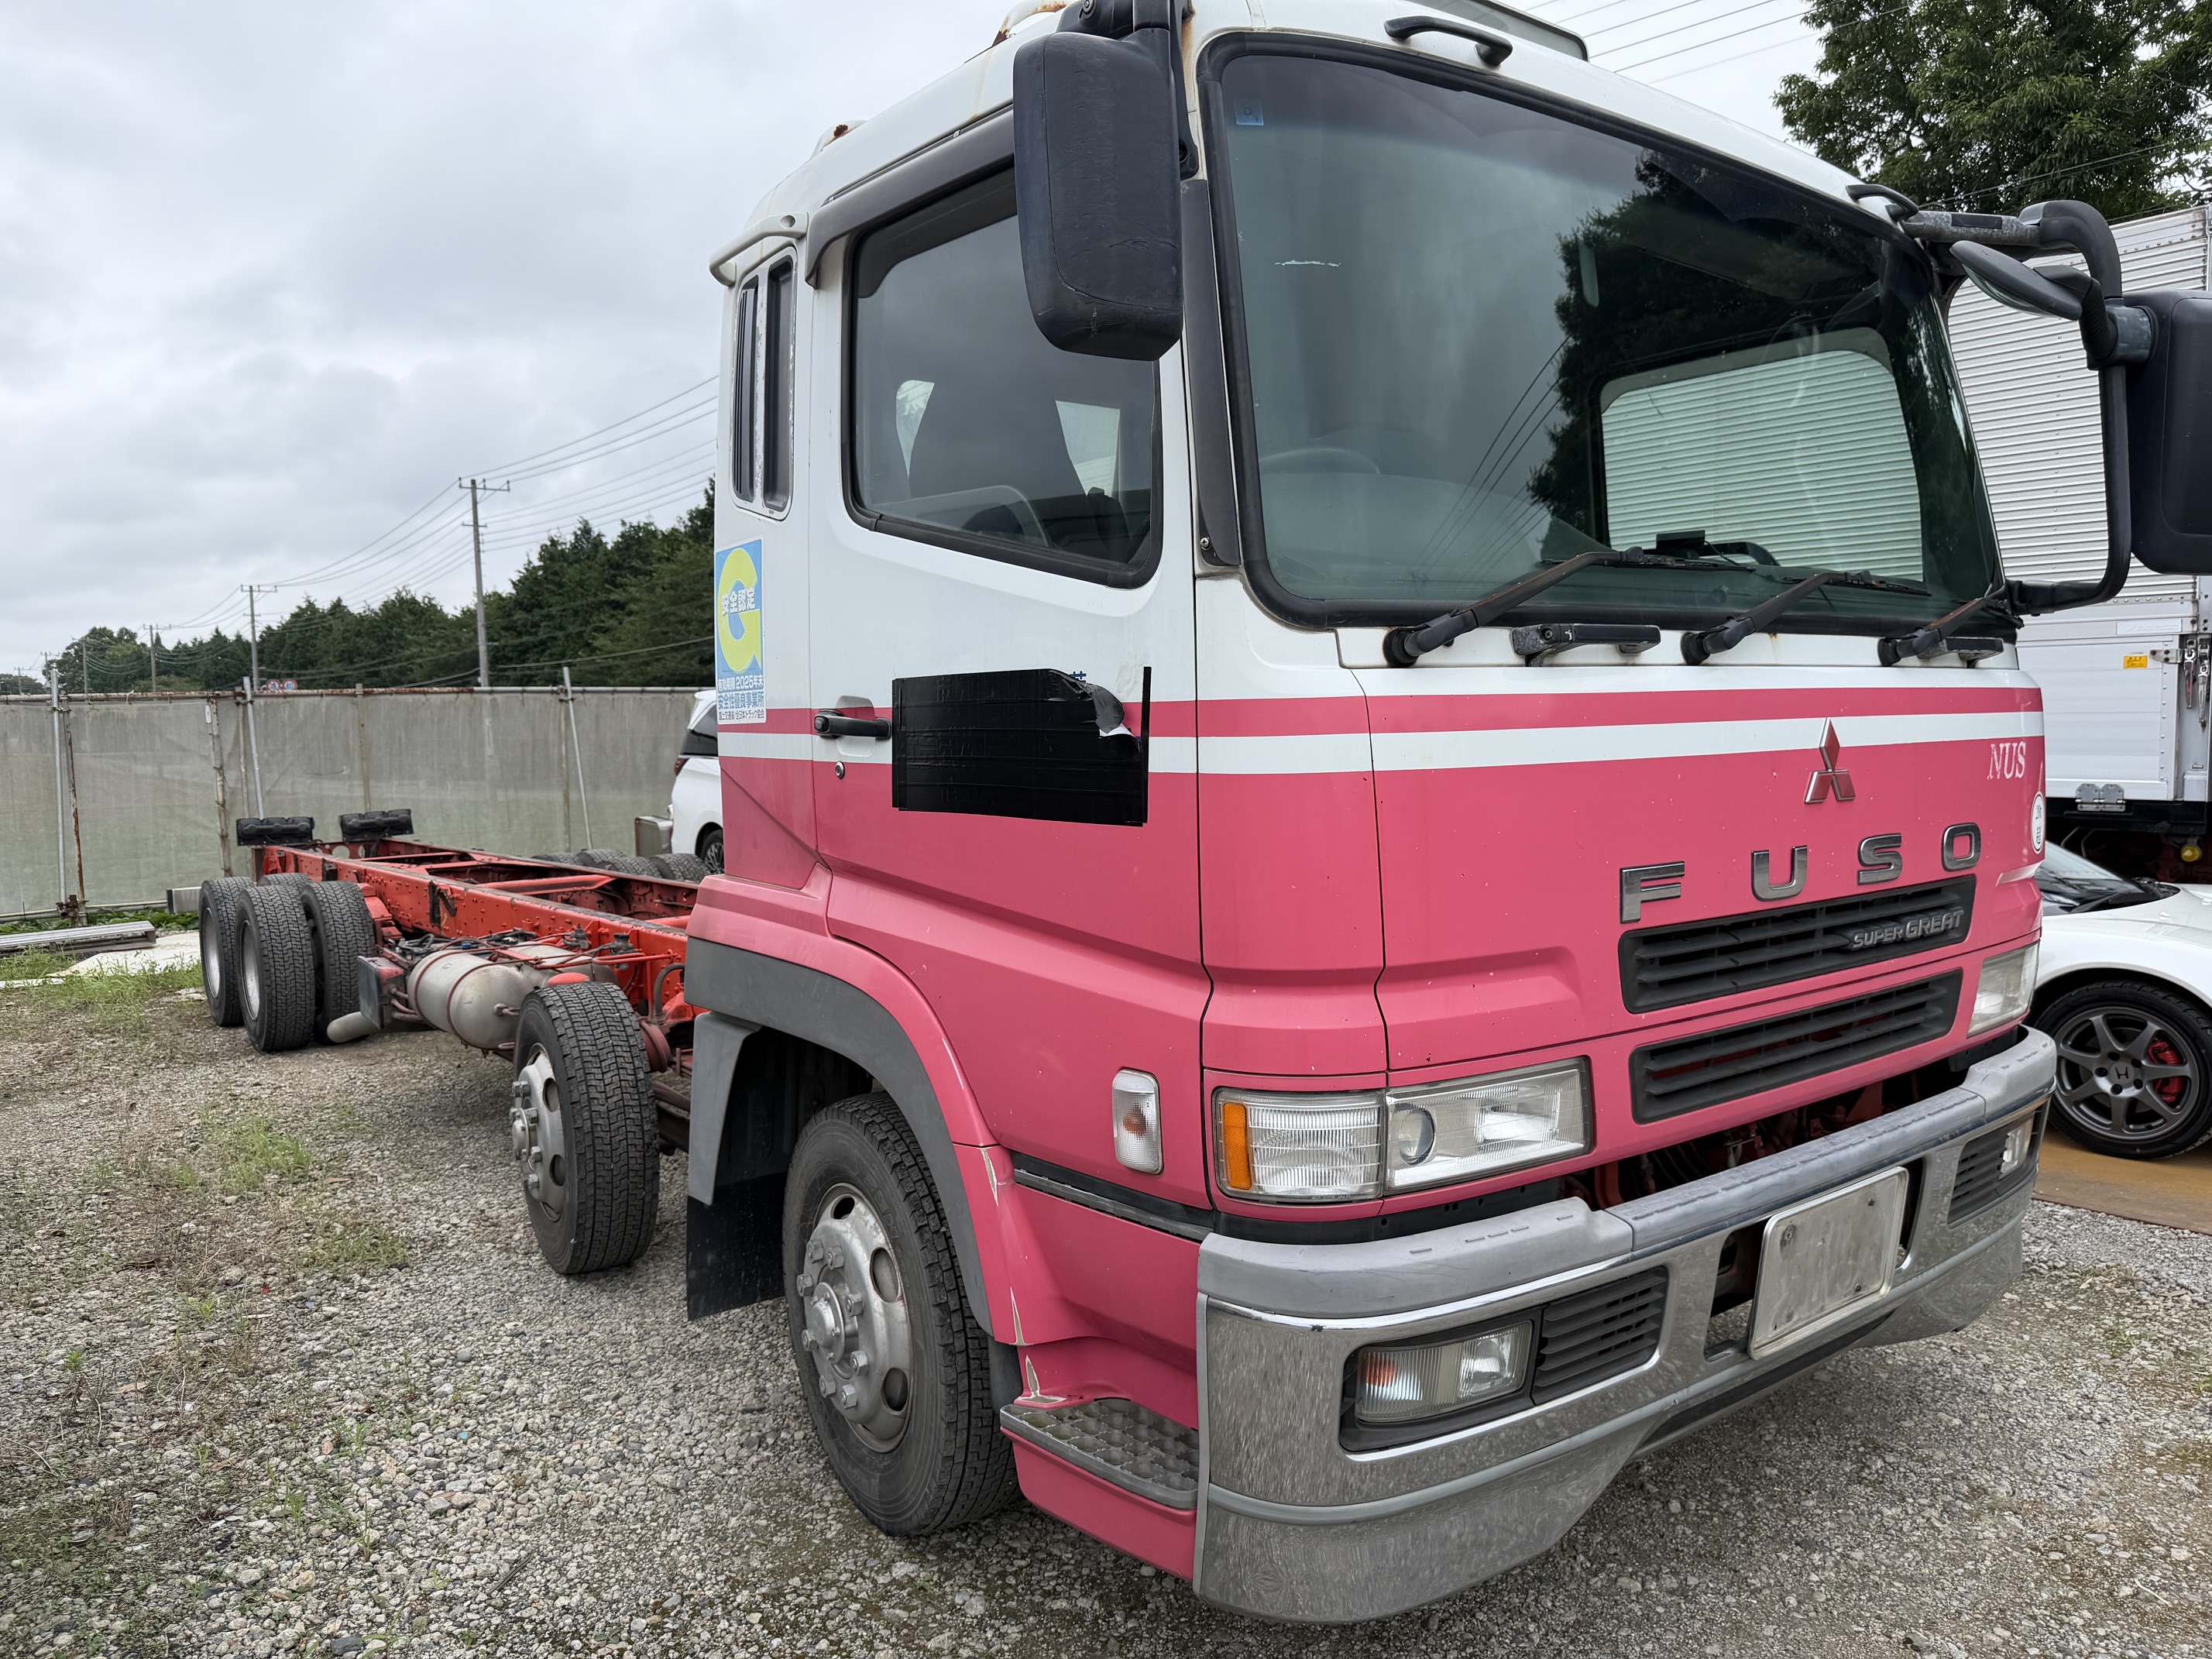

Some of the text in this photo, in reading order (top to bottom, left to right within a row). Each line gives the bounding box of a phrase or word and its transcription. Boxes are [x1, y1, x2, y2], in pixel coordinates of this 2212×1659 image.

[721, 587, 756, 616] 安全認定
[718, 691, 764, 709] 安全性優良事業所
[1987, 741, 2026, 780] NUS
[1620, 822, 1981, 923] FUSO
[1853, 908, 1965, 949] SUPER GREAT
